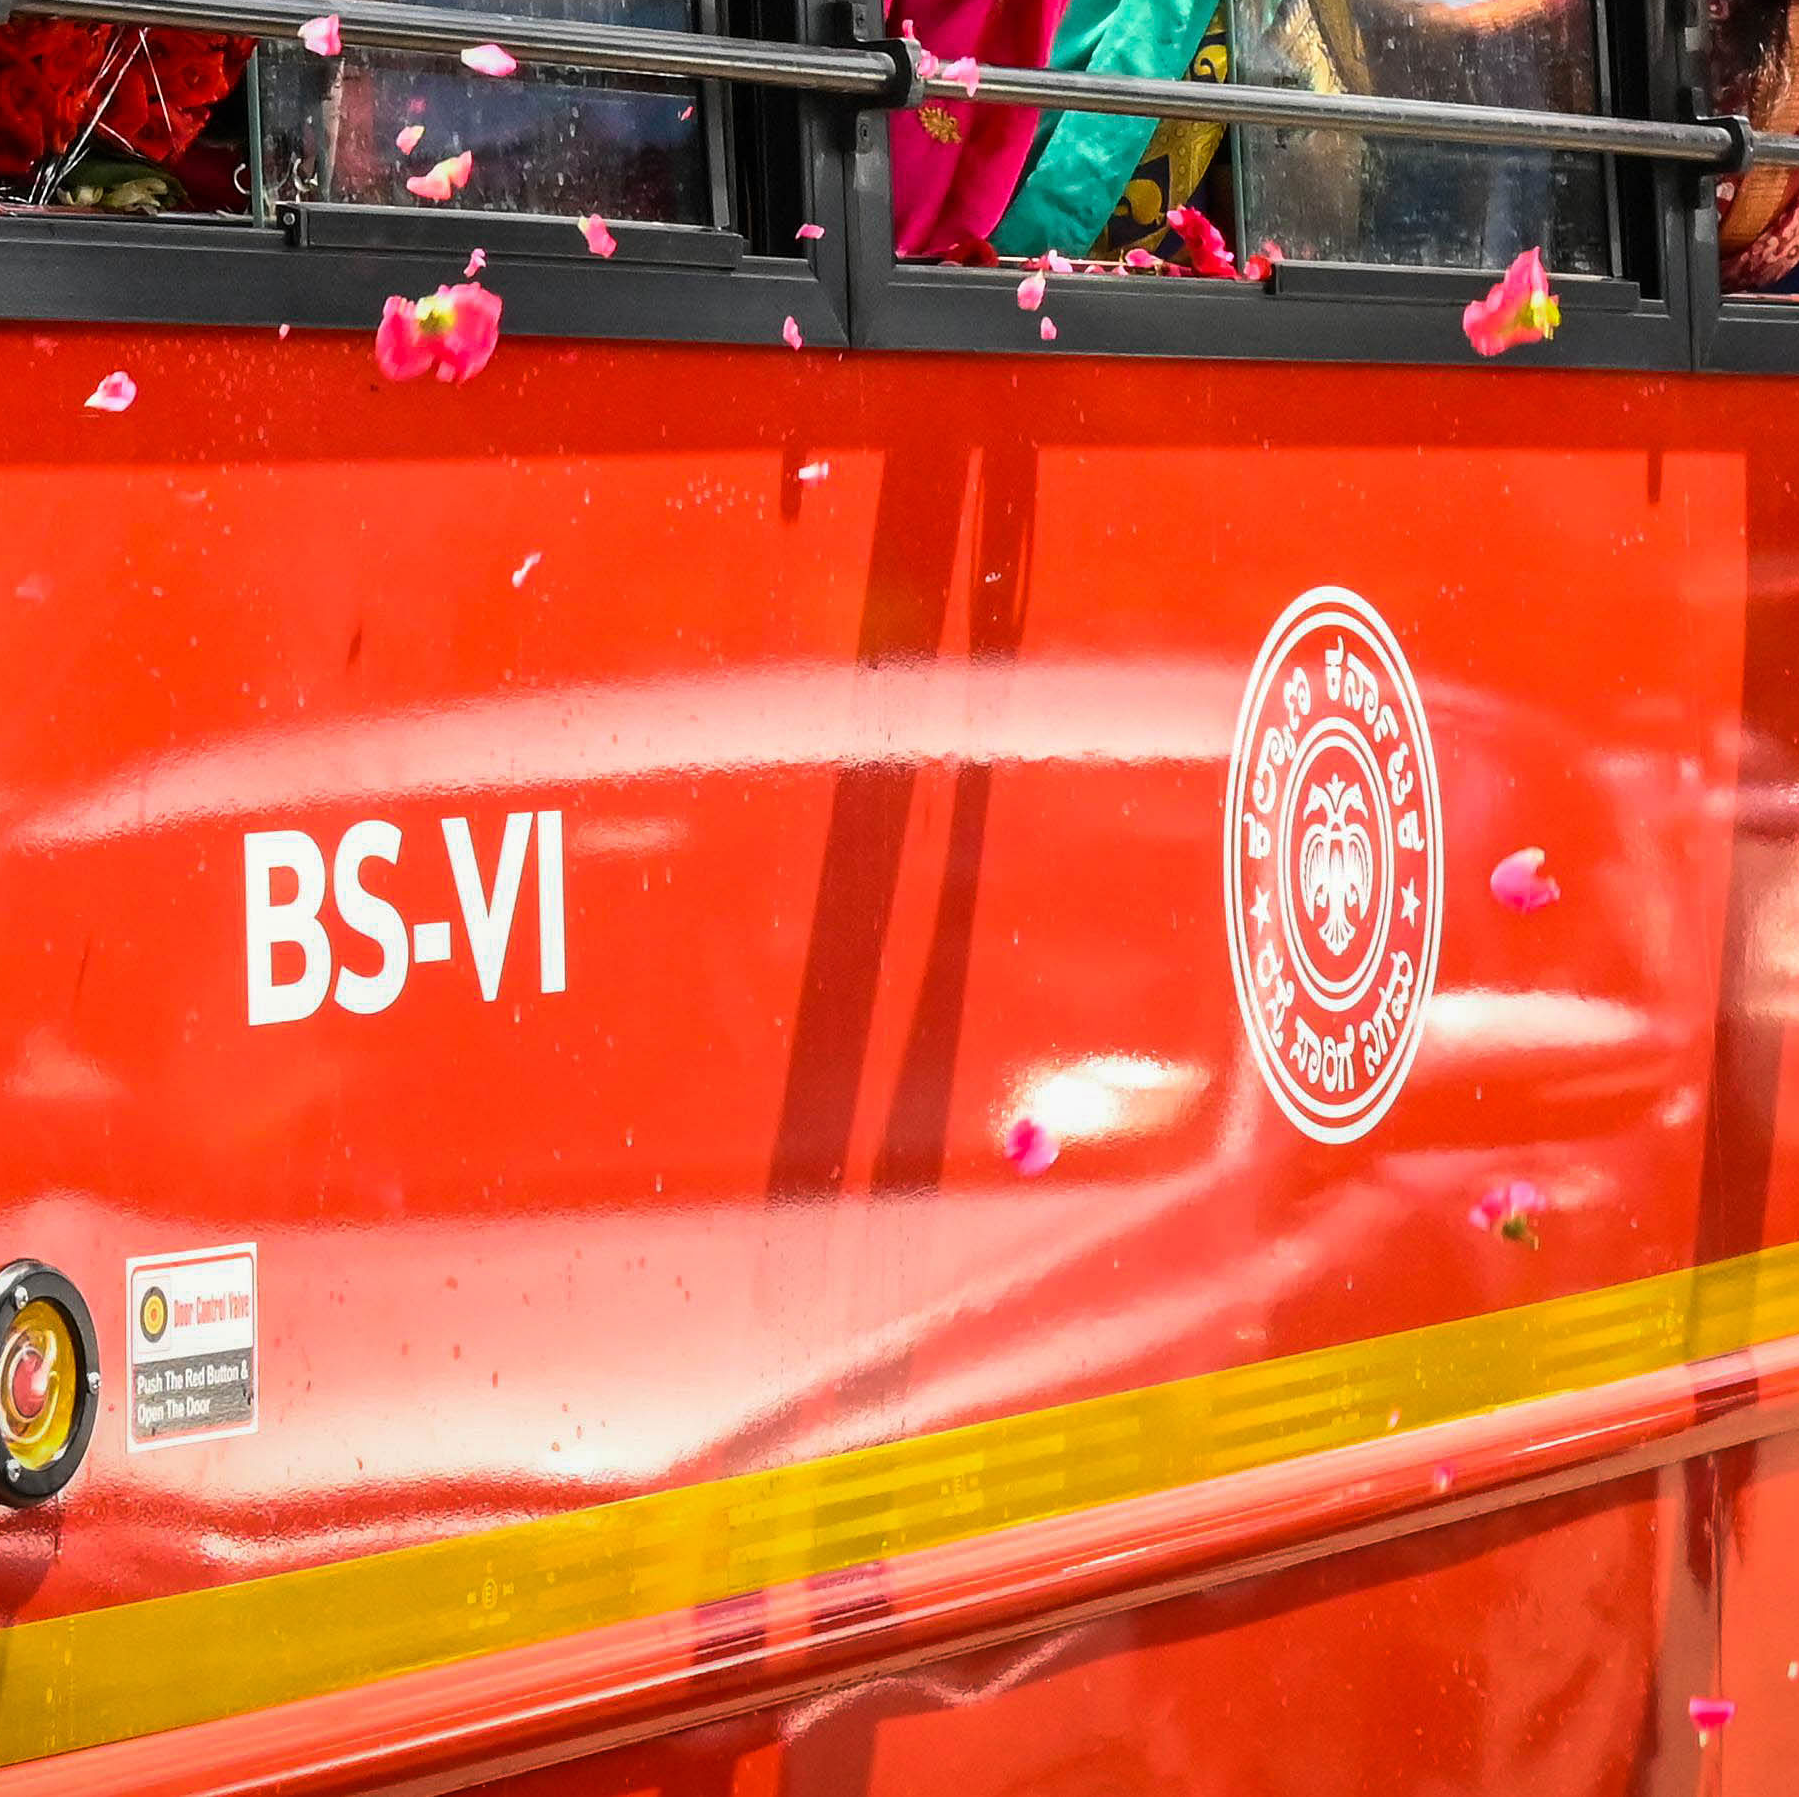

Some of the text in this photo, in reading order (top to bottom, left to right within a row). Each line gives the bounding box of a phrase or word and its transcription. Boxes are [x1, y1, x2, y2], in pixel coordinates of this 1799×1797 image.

[1242, 635, 1426, 860] ಕಲ್ಯಾಣ ಕರ್ನಾಟಕ
[243, 810, 567, 1027] BS-VI
[1289, 1015, 1356, 1092] ಸಾರಿಗೆ
[1359, 950, 1414, 1078] ನಿಗಮ
[137, 1359, 249, 1395] Push The Red Button &
[137, 1396, 211, 1428] Open The Door
